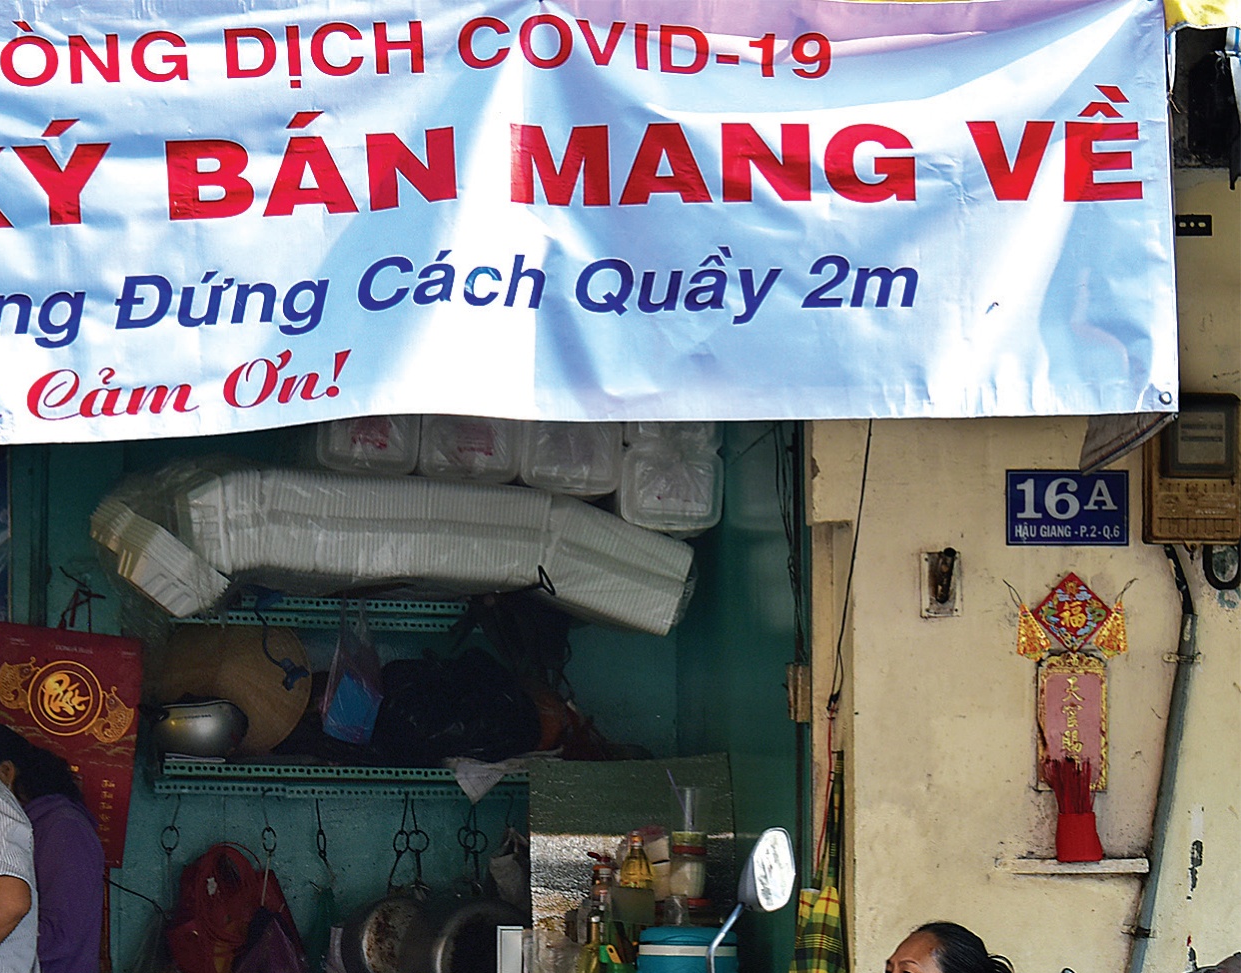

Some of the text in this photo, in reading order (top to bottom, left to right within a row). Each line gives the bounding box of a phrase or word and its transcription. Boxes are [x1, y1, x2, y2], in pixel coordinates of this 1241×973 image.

[225, 21, 425, 88] DỊCH
[457, 14, 833, 79] COVID-19
[164, 111, 458, 220] BÁN
[509, 122, 916, 209] MANG
[965, 86, 1145, 202] VỀ
[115, 270, 330, 335] Đứng
[358, 250, 547, 312] Cách
[575, 246, 782, 325] Quầy
[801, 254, 918, 309] 2m
[27, 368, 201, 420] Cảm
[222, 350, 353, 410] Ơn!
[1014, 522, 1037, 542] HẬU
[1040, 525, 1071, 538] GIANG
[1016, 477, 1118, 520] 16A
[1060, 600, 1087, 629] 福
